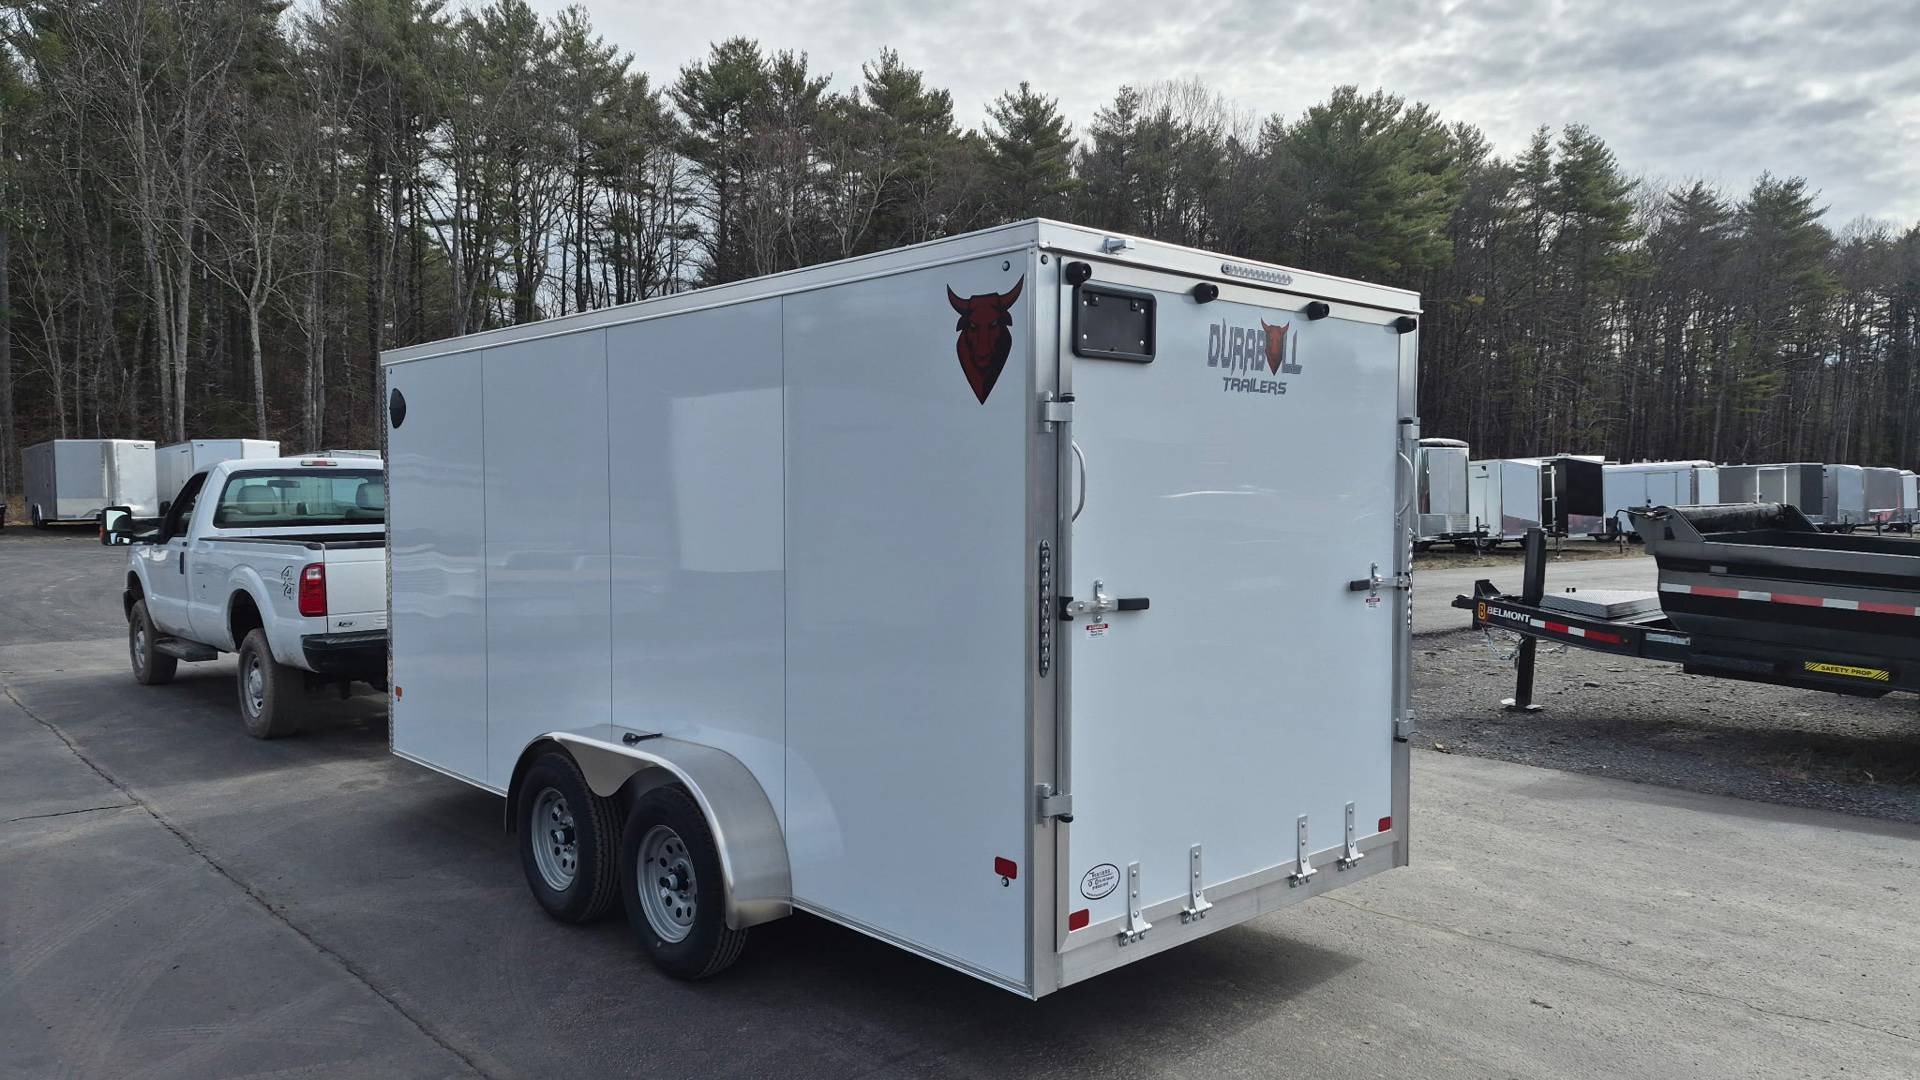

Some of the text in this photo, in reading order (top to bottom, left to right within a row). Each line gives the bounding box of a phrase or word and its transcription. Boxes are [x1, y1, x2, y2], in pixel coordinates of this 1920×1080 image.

[1207, 317, 1302, 376] DURABLL
[1222, 377, 1287, 395] TRAILERS
[1487, 606, 1530, 622] BELMONT
[1820, 666, 1849, 674] SAFETY
